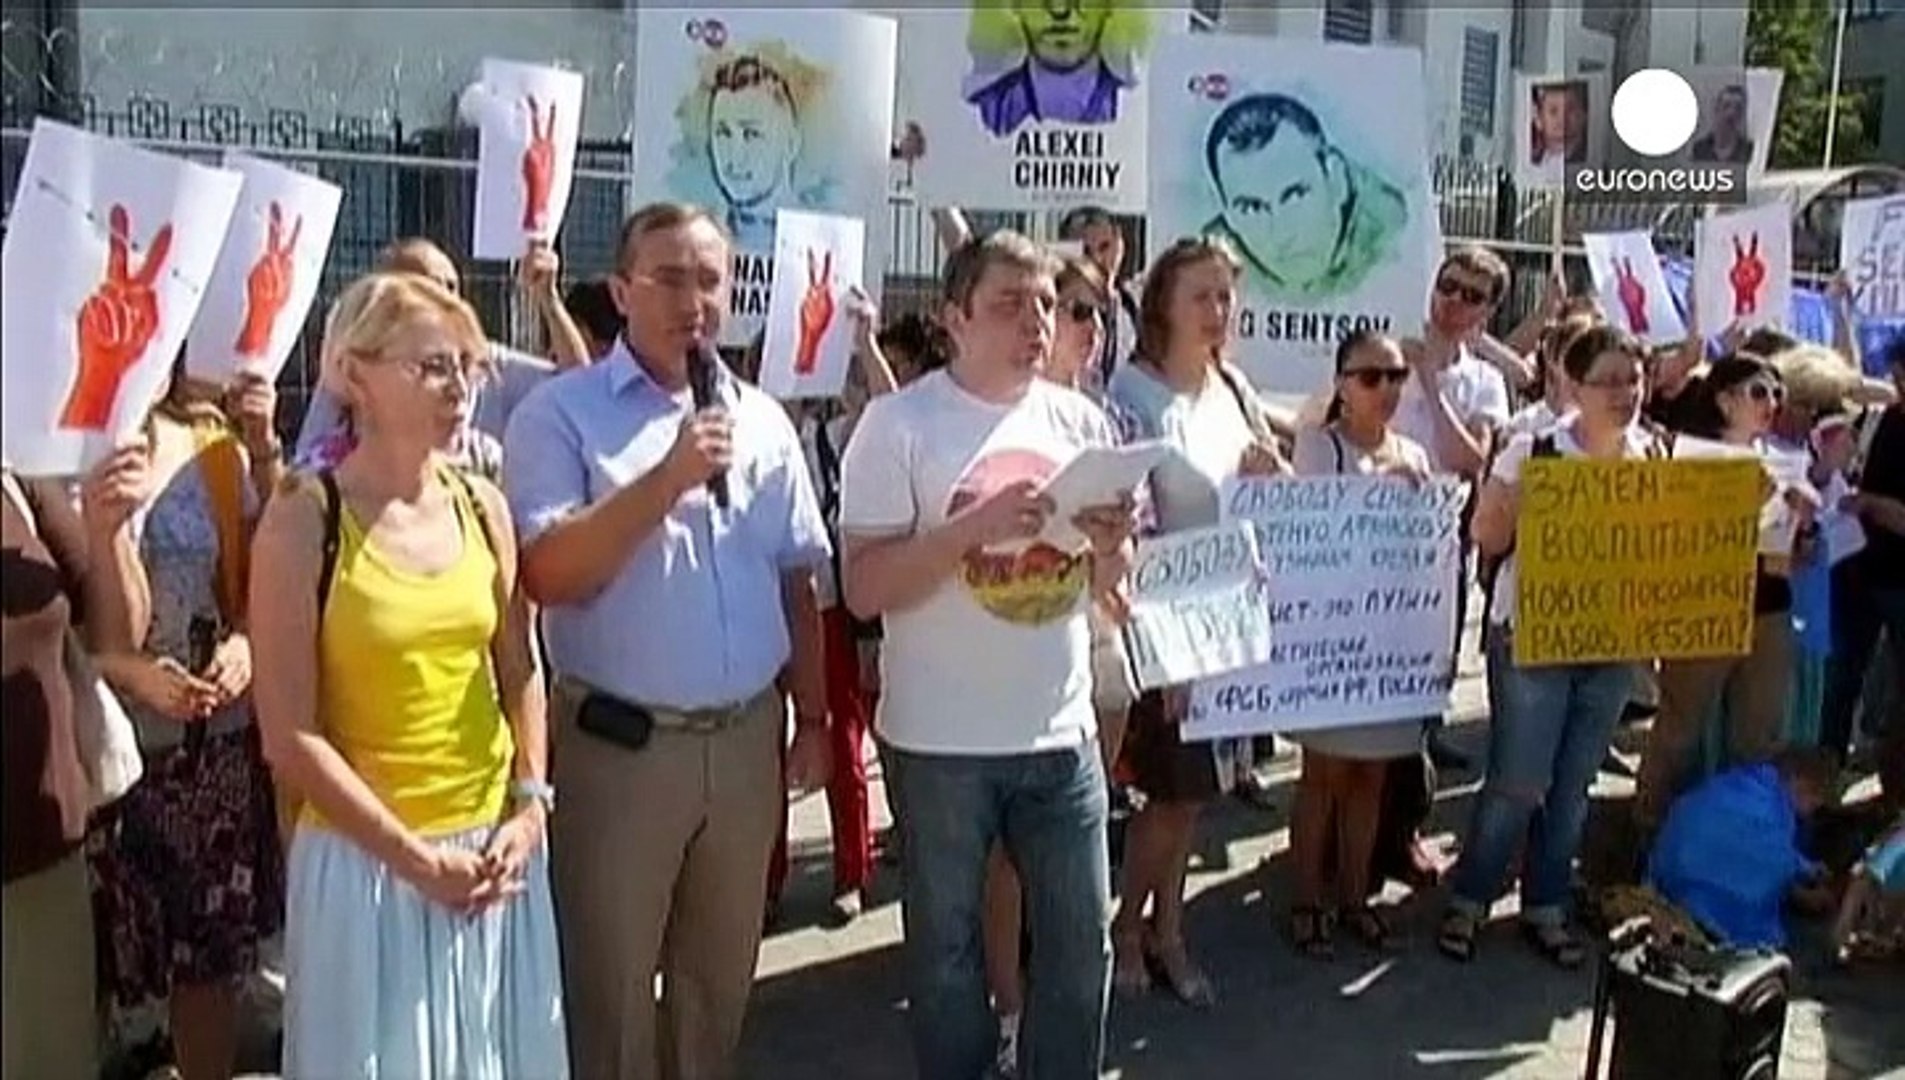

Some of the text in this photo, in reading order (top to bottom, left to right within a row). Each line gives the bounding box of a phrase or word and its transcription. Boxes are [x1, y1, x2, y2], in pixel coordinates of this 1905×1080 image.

[1016, 130, 1103, 157] ALEXEI
[1015, 160, 1120, 189] CHIRNIY
[1266, 310, 1390, 342] SENTSOV
[1230, 480, 1348, 515] СВОБОДУ
[1528, 463, 1659, 514] ЗАЧЕМ
[1136, 531, 1252, 593] СВОБОДУ
[1364, 588, 1442, 615] ПУТИН
[1518, 575, 1603, 626] НОВОЕ
